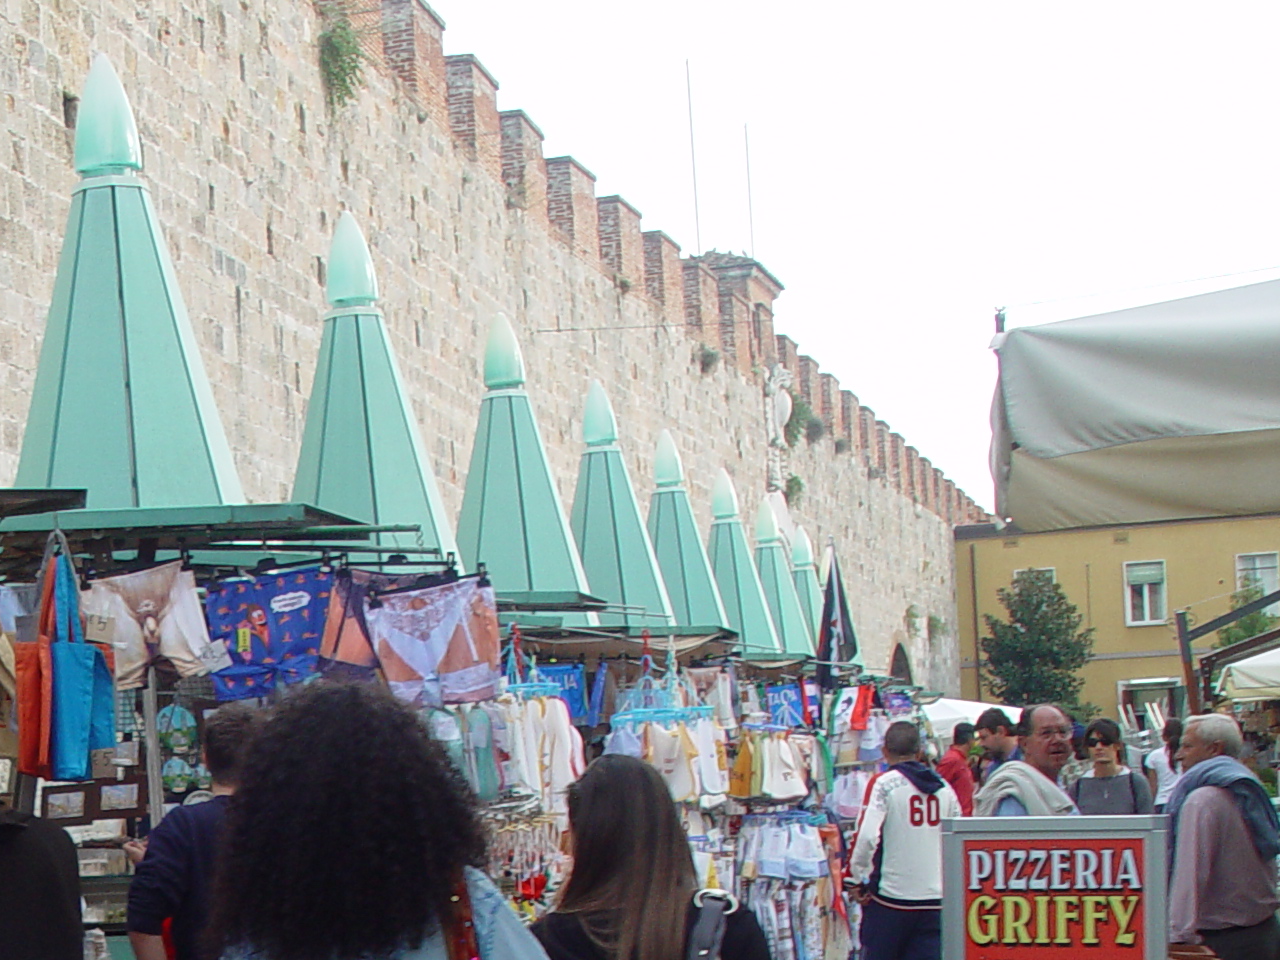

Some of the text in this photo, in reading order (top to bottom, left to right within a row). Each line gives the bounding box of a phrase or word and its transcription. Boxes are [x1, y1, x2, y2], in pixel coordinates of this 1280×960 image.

[909, 794, 940, 827] 60
[967, 848, 1143, 891] PIZZERIA
[967, 895, 1140, 946] GRIFFY
